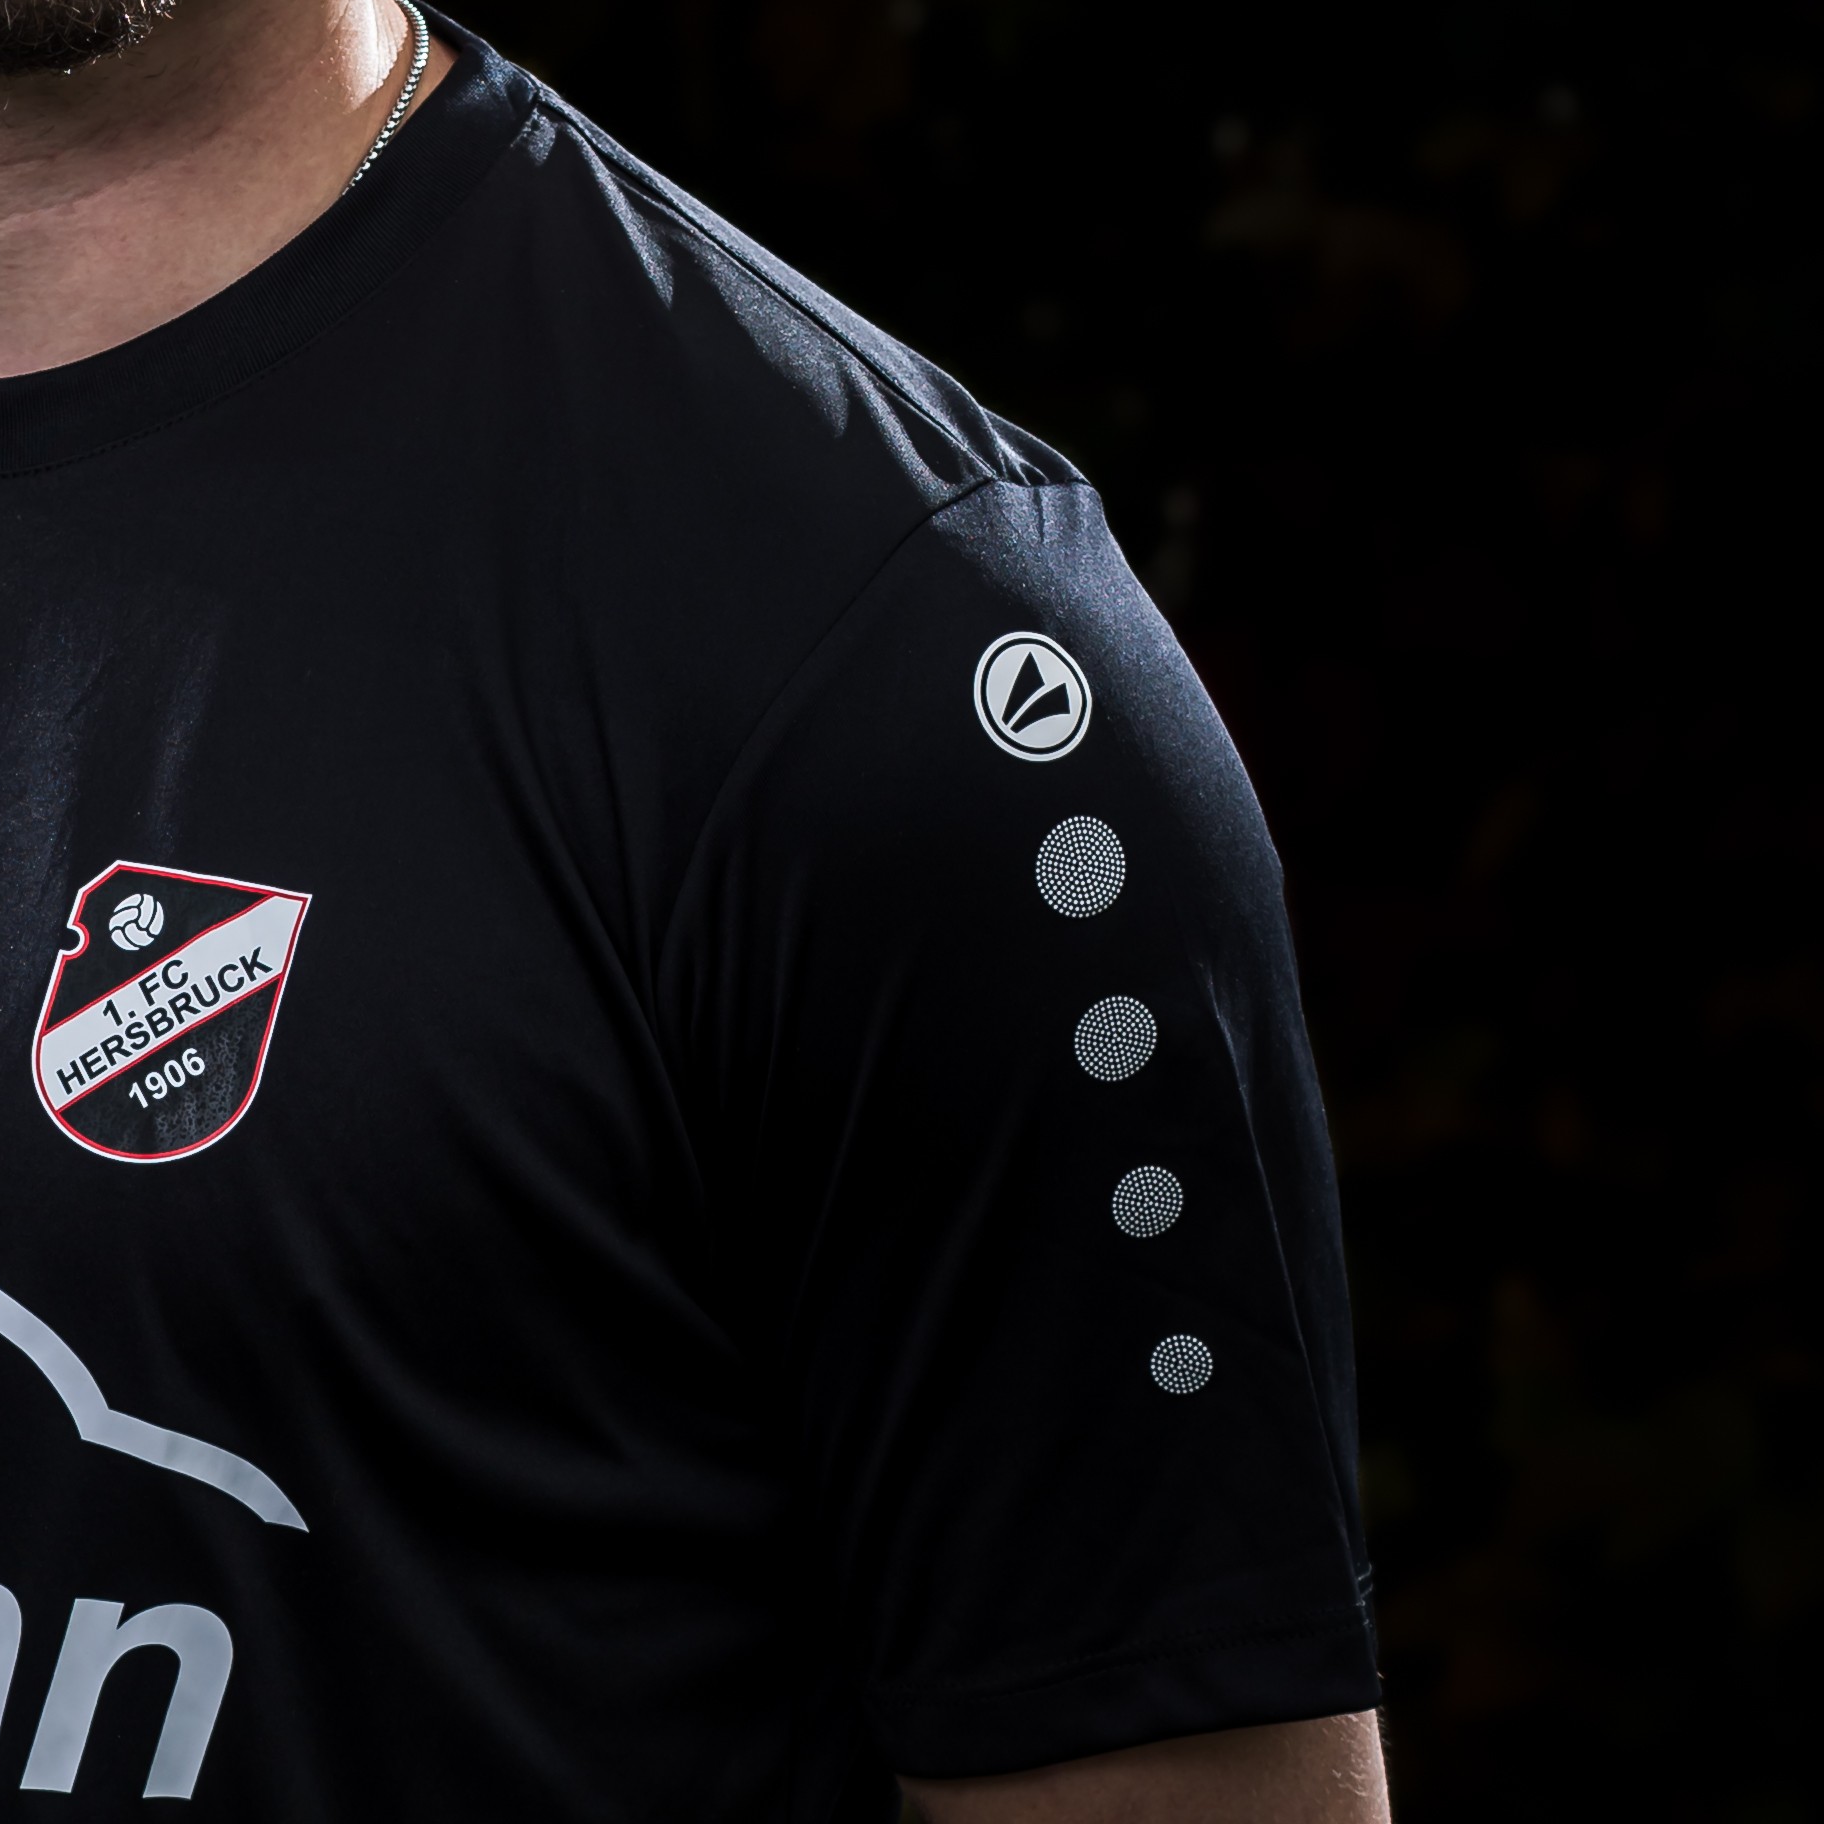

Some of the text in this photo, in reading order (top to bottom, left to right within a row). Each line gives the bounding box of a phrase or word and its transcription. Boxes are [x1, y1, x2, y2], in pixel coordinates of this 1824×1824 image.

[55, 945, 274, 1096] HERSBRUCK
[101, 958, 190, 1028] 1. FC
[127, 1046, 207, 1110] 1906
